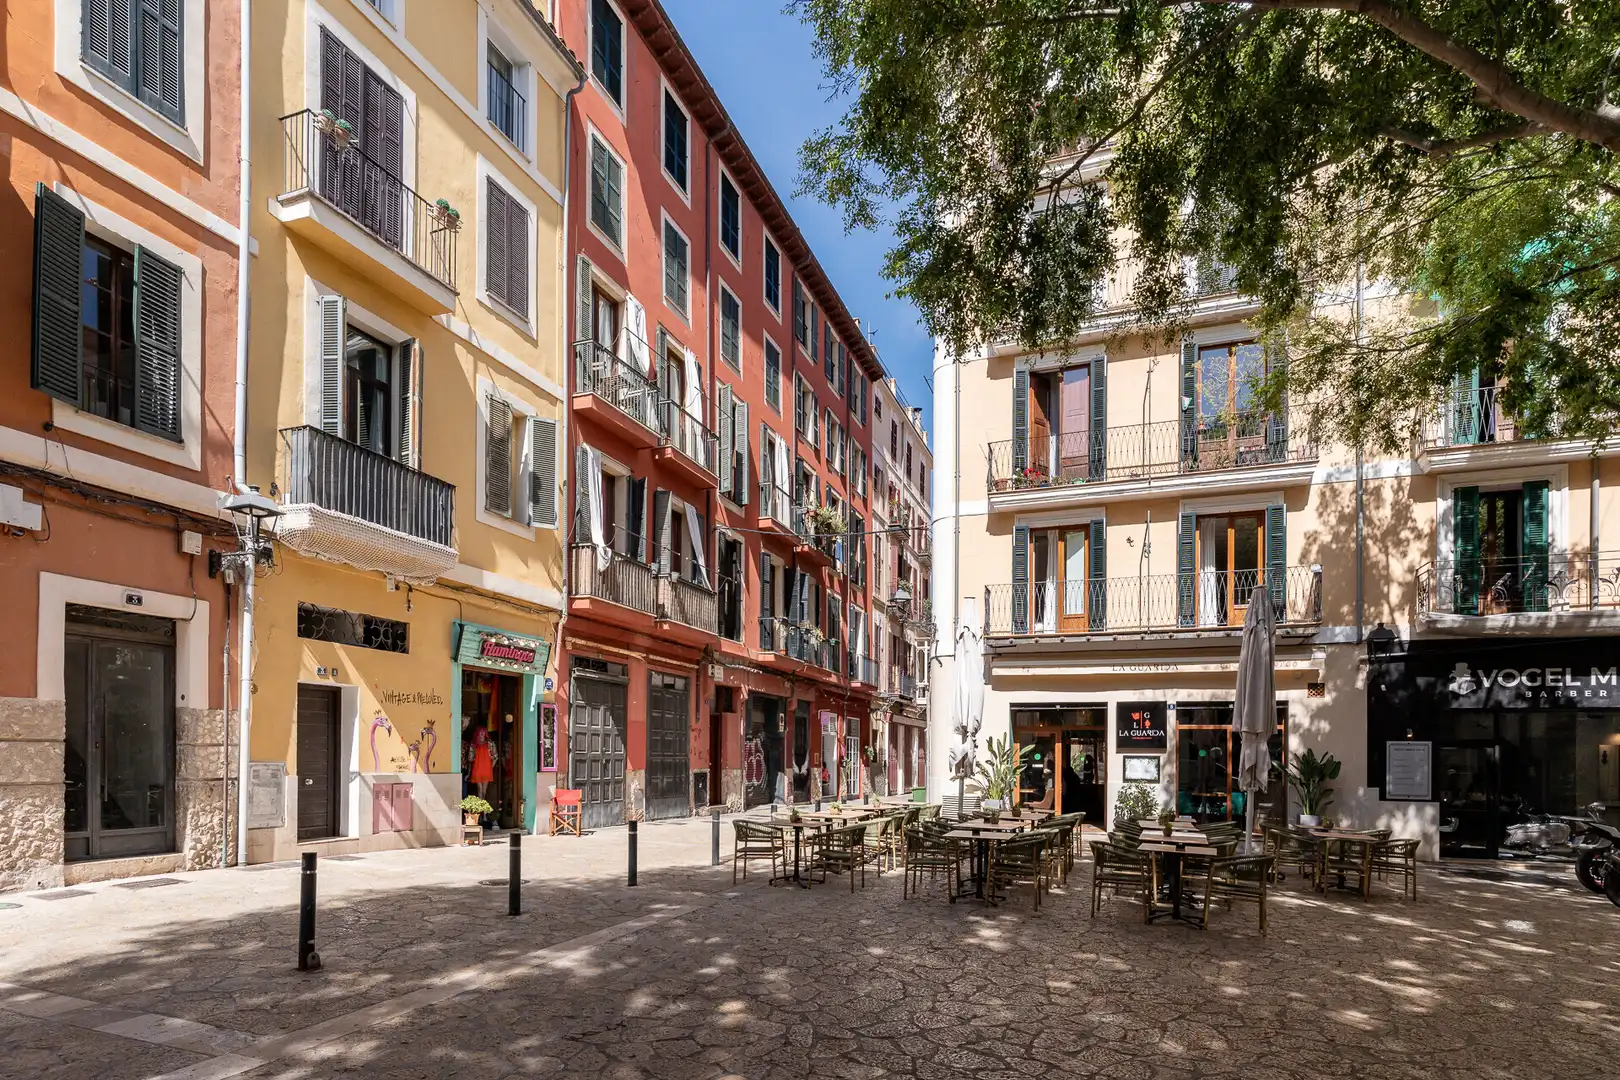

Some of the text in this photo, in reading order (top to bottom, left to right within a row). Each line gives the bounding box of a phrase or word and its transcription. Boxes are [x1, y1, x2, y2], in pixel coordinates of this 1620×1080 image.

[1112, 663, 1179, 672] LA GUARIDA
[1477, 668, 1581, 688] VOGEL
[1525, 690, 1608, 698] BARBER
[1143, 711, 1151, 719] G
